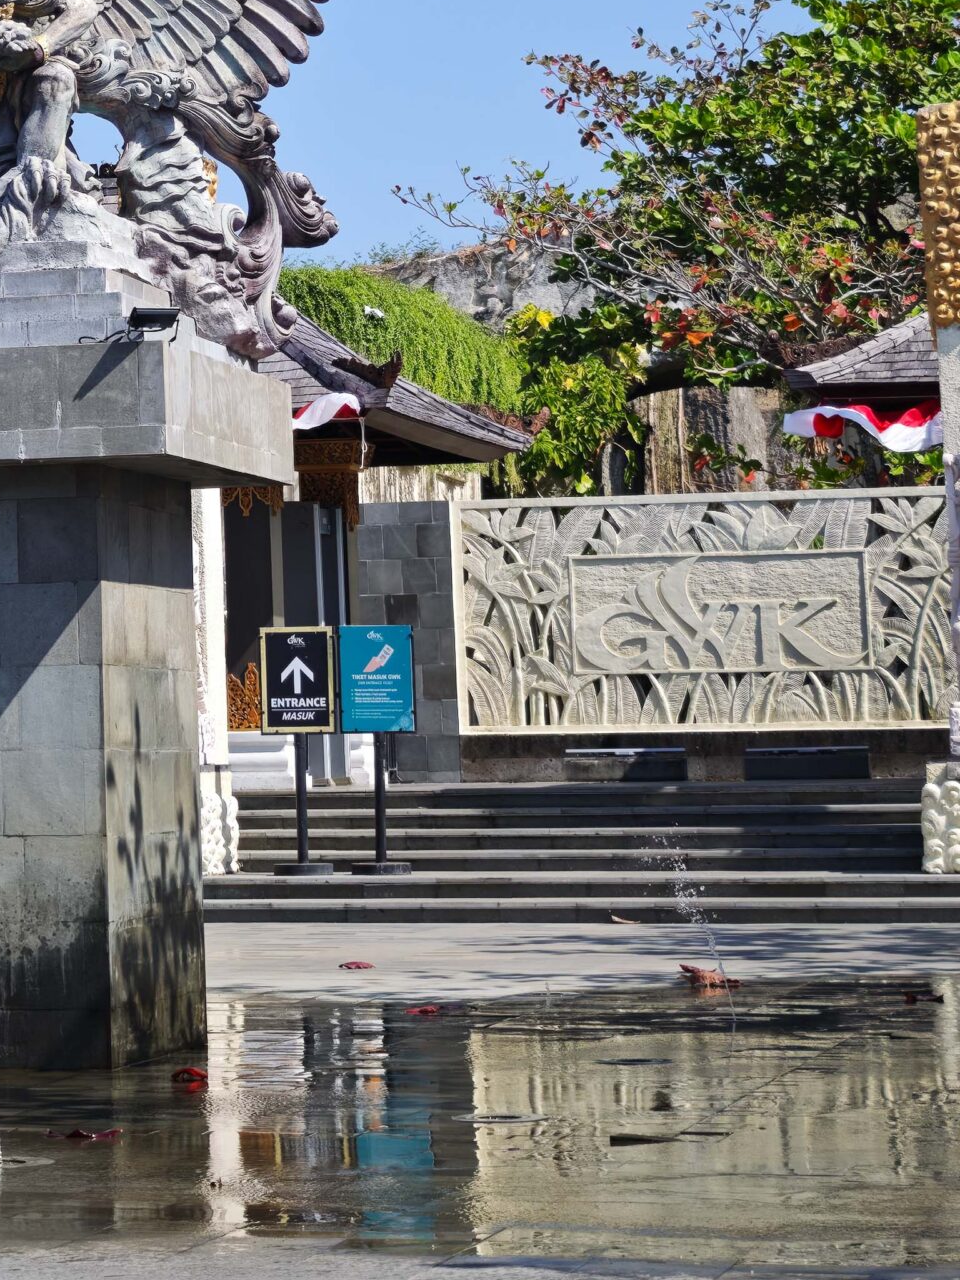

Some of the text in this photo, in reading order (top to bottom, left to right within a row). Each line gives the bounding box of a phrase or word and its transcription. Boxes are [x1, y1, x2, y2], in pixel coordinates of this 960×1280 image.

[576, 556, 871, 672] GWK
[288, 634, 305, 645] GWK
[271, 698, 326, 708] ENTRANCE
[282, 711, 315, 721] MASUK
